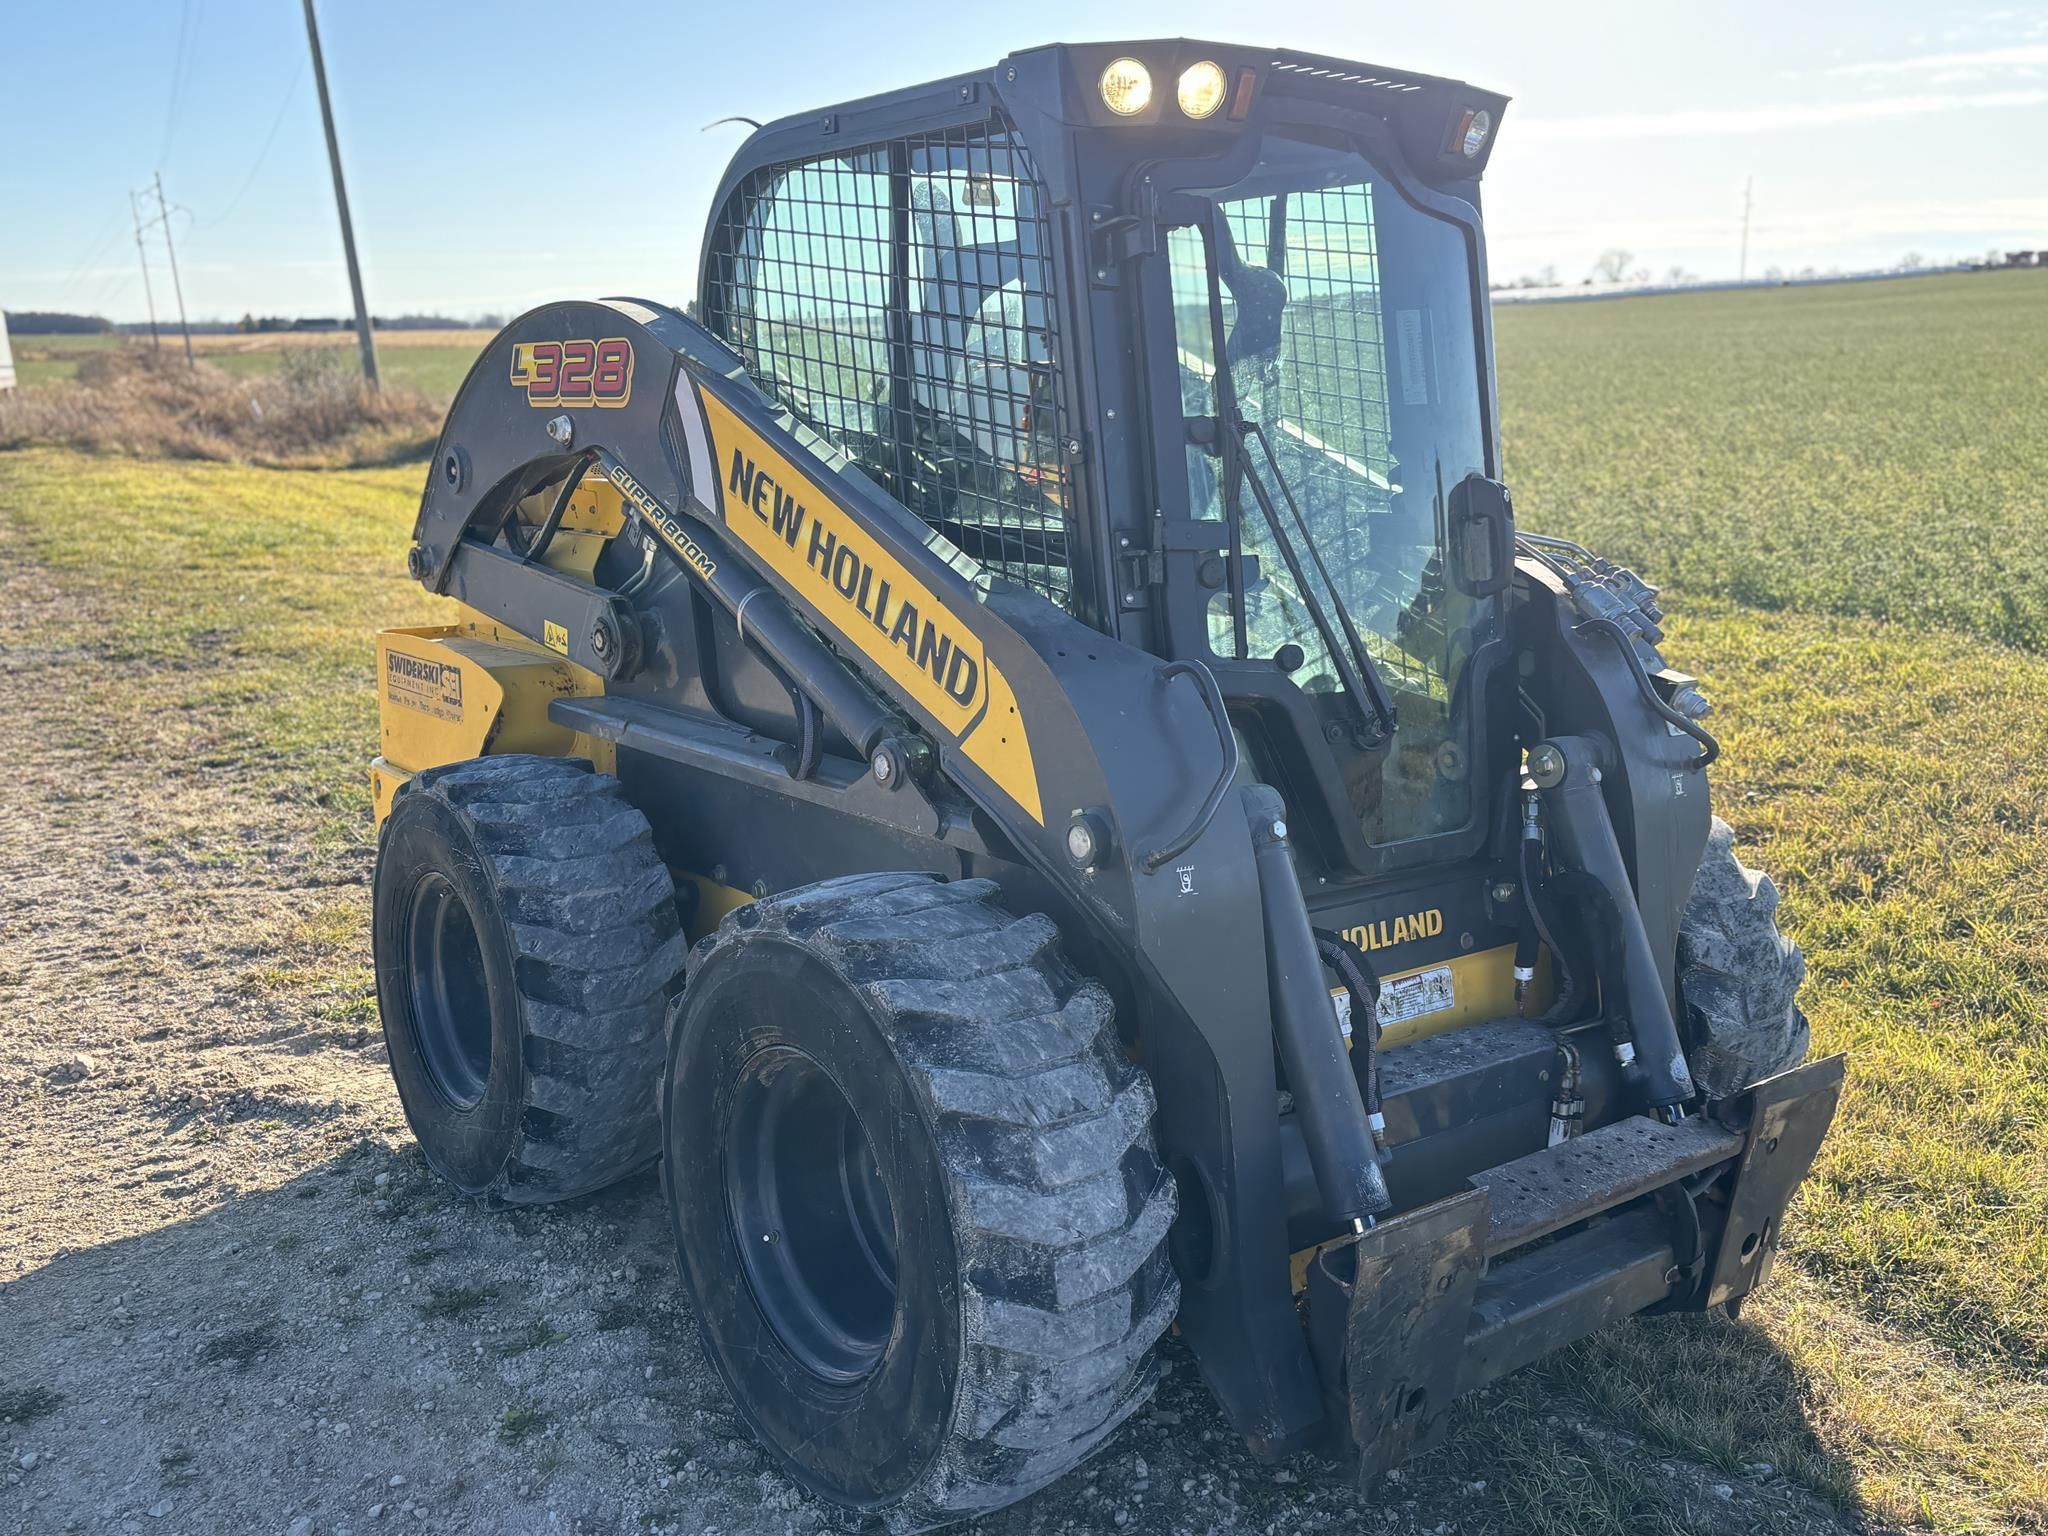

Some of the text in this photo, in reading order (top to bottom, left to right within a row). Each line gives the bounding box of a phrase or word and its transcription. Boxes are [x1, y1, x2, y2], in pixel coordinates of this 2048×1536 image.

[511, 337, 634, 408] L328
[611, 466, 717, 581] SUPER BOOM
[728, 447, 979, 709] NEW HOLLAND
[388, 653, 440, 686] SWIDERSKI
[389, 673, 425, 693] EQUIPMENT
